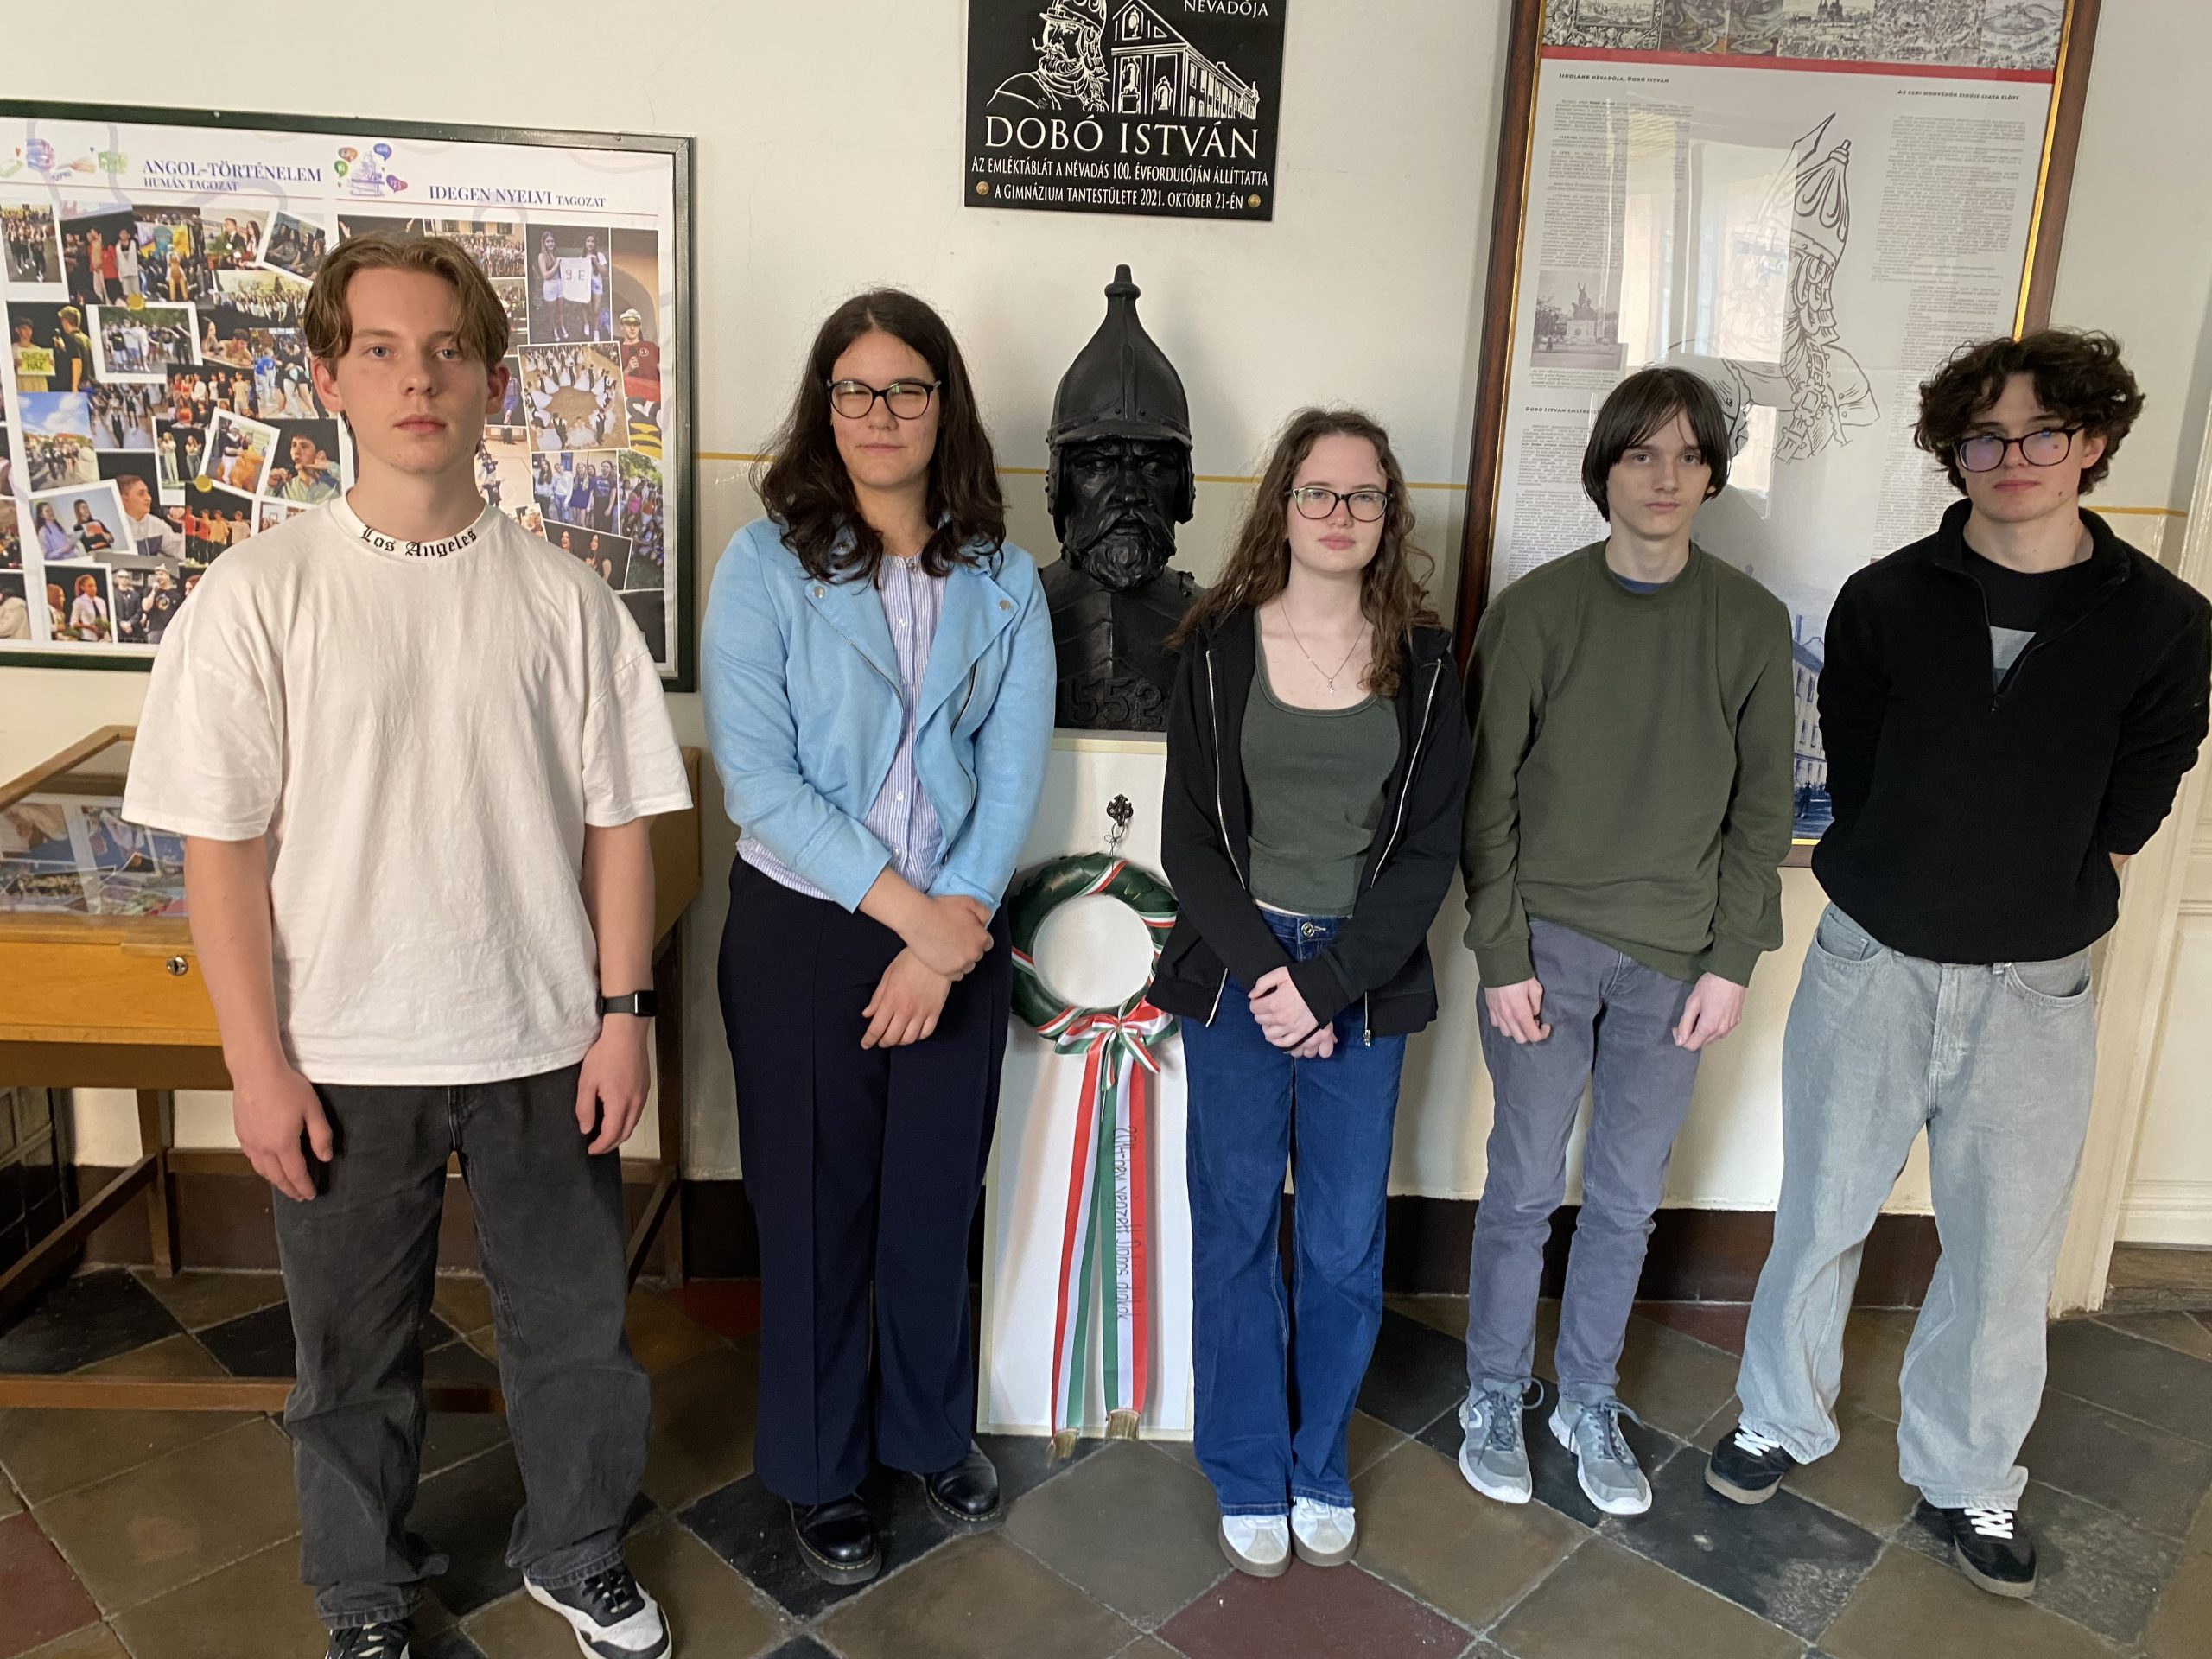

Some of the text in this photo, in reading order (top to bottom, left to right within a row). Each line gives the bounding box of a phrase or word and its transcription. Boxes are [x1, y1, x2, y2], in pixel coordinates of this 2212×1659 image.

[984, 114, 1259, 159] DOBÓ ISTVÁN
[143, 159, 321, 182] ANGOL-TÖRTÉNELEM
[143, 176, 238, 191] HUMÁN TAGOZAT
[971, 156, 1268, 186] AZ EMLÉKTÁBLÁT A NÉVADÁS 100. ÉVFORDULÓJÁN ÁLLÍTTATTA
[429, 185, 606, 207] IDEGEN NYELVI TAGOZAT
[995, 181, 1243, 210] A GIMNÁZIUM TANTESTÜLETE 2021. OKTÓBER 21-ÉN
[360, 524, 477, 558] Los Angeles
